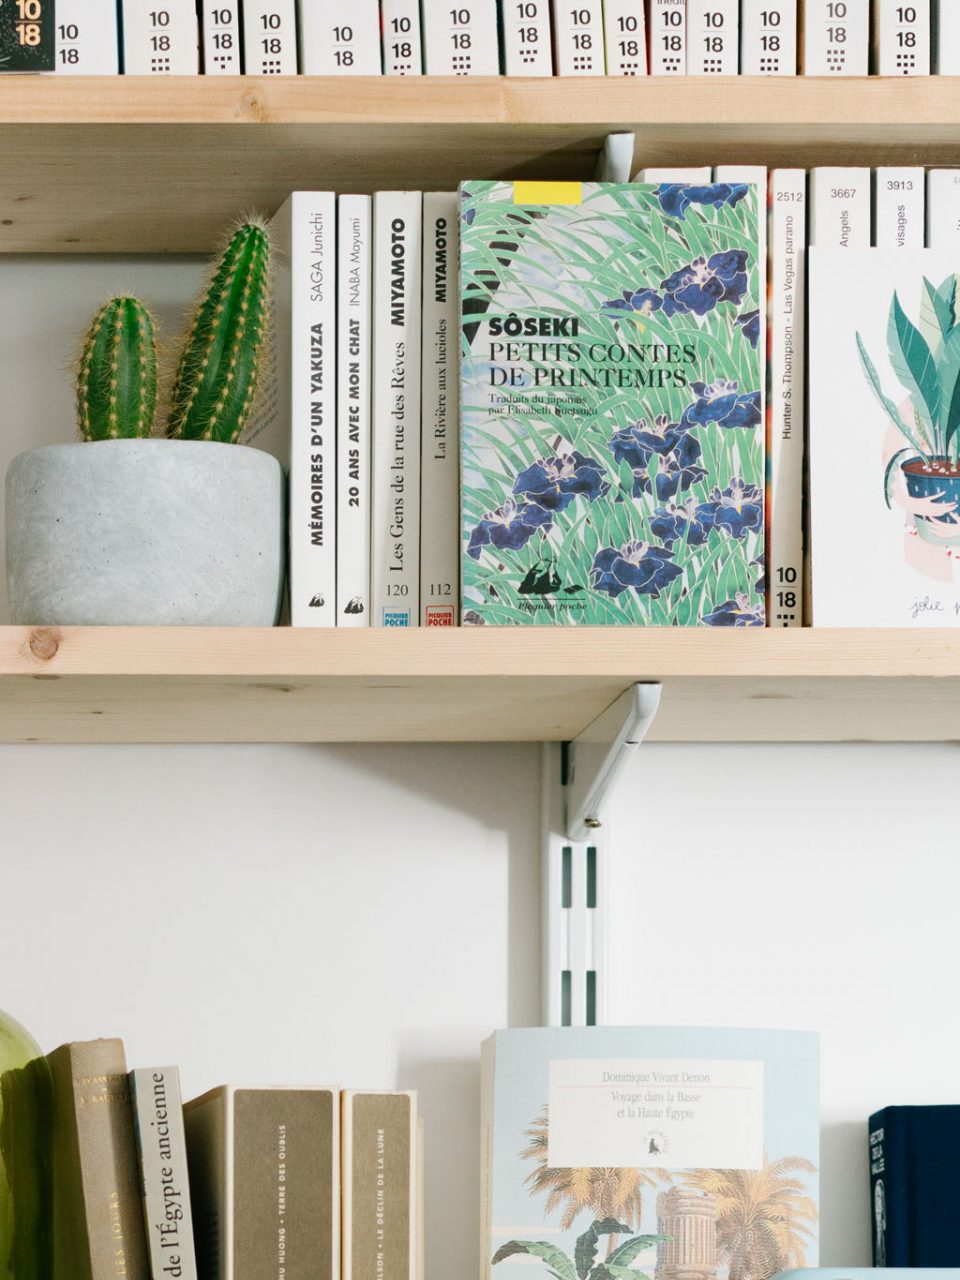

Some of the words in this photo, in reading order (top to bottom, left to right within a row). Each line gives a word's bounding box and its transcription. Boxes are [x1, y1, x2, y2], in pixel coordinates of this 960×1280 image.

[150, 11, 169, 26] 10
[761, 11, 780, 26] 10
[151, 36, 170, 51] 18
[761, 36, 780, 51] 18
[831, 189, 856, 198] 3667
[887, 181, 913, 190] 3913
[309, 213, 323, 256] Junichi
[840, 211, 850, 247] Angels
[896, 205, 907, 246] visages
[350, 218, 363, 263] Mayumi
[311, 261, 323, 301] SAGA
[349, 267, 360, 306] INABA
[391, 219, 405, 326] MIYAMOTO
[349, 319, 359, 355] CHAT
[489, 313, 578, 336] SÔSEKI
[311, 323, 322, 393] YAKUZA
[391, 343, 404, 388] Rêves
[490, 343, 581, 362] PETITS
[589, 343, 697, 363] CONTES
[349, 363, 359, 399] MON
[490, 368, 524, 386] DE
[535, 368, 687, 387] PRINTEMPS
[391, 395, 404, 420] des
[311, 402, 322, 446] D'UN
[349, 406, 359, 442] AVEC
[394, 426, 404, 450] rue
[349, 449, 359, 480] ANS
[391, 457, 404, 469] la
[349, 487, 359, 506] 20
[391, 476, 404, 493] de
[308, 454, 323, 546] MÉMOIRES
[390, 498, 403, 538] Gens
[390, 544, 403, 570] Les
[388, 585, 408, 595] 120
[151, 1074, 171, 1159] ancienne
[163, 1256, 181, 1277] de
